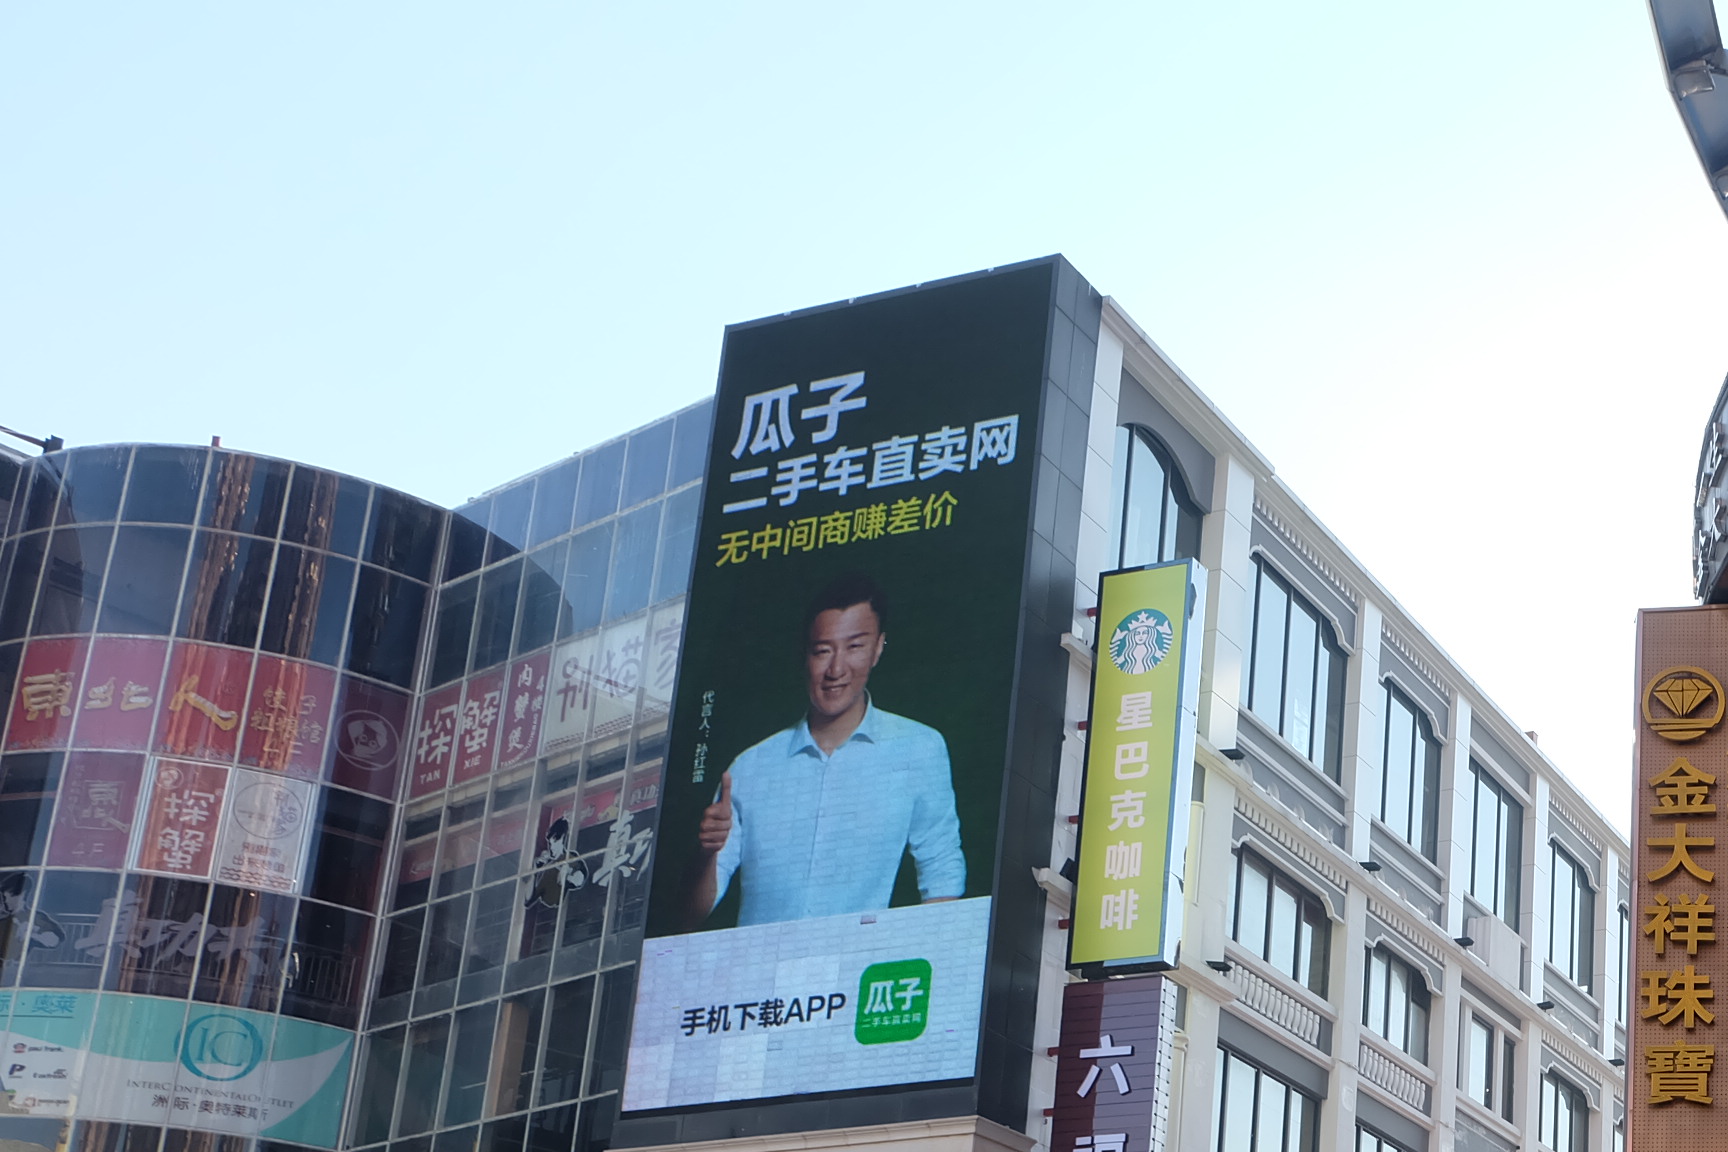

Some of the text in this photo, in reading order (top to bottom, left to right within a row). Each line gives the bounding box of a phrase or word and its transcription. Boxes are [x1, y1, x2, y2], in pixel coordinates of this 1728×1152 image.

[731, 370, 868, 460] 瓜子
[722, 414, 1020, 514] 二手车直卖网
[715, 489, 959, 568] 无中间商赚差价
[419, 754, 482, 785] TAN XIE
[1099, 690, 1155, 932] 星巴克咖啡
[680, 992, 847, 1038] 手机下载APP
[863, 976, 924, 1015] 瓜子
